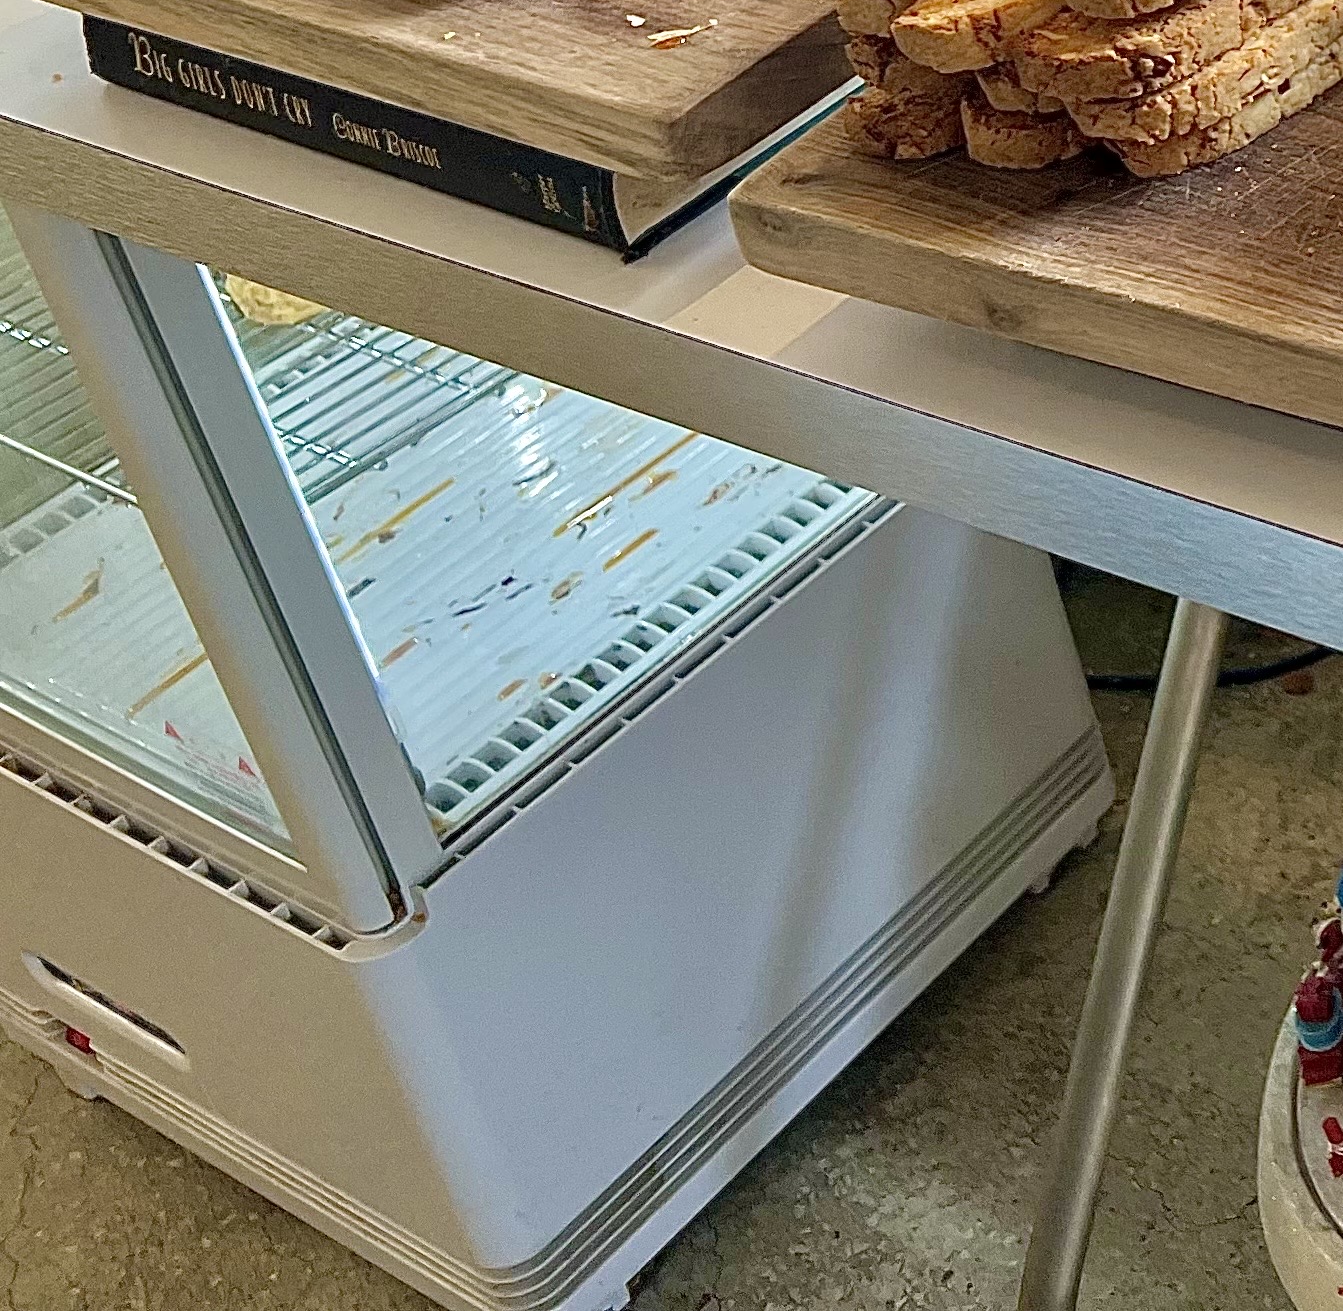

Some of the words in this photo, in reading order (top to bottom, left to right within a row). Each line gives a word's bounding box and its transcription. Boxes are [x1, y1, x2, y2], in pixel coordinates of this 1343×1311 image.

[178, 58, 226, 100] GIRLS
[230, 74, 279, 117] DON'T
[283, 93, 312, 128] CRY
